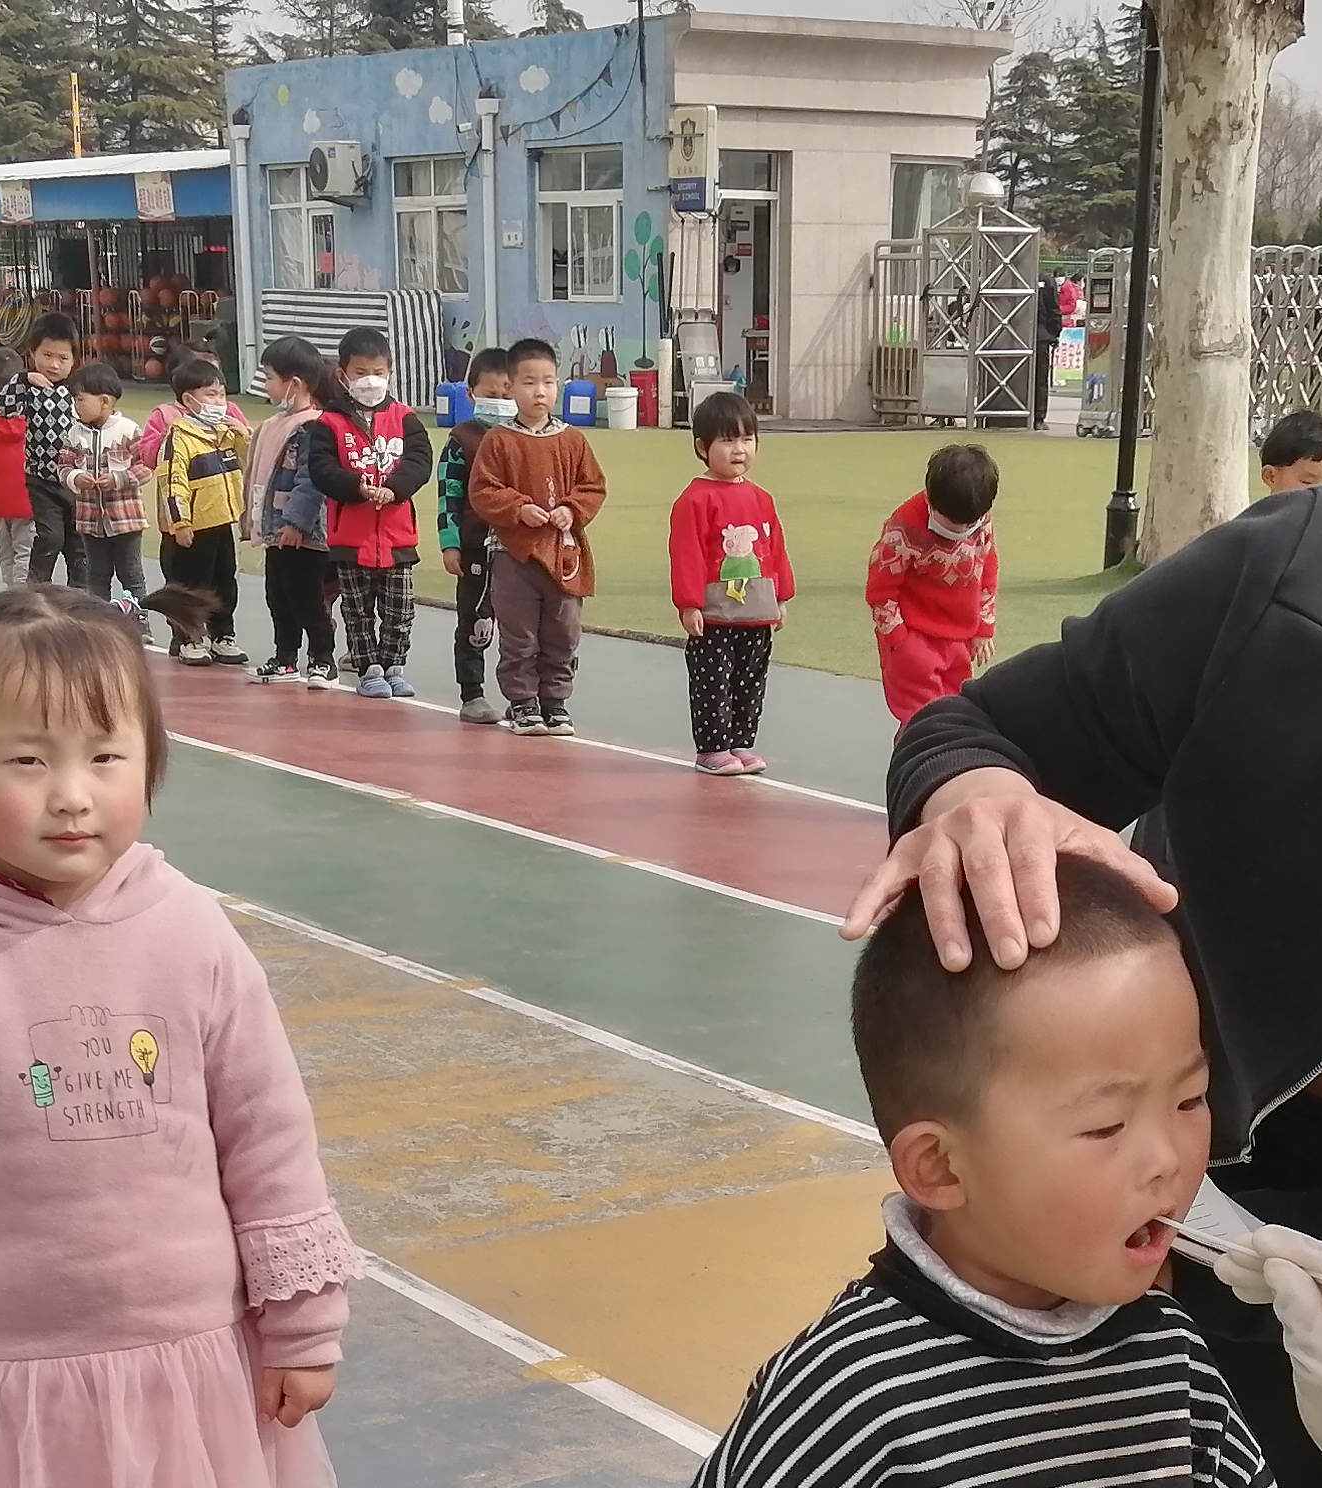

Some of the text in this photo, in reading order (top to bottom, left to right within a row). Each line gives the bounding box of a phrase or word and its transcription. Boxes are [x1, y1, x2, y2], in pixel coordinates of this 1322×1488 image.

[80, 1037, 112, 1058] YOU
[65, 1068, 133, 1093] GIVE ME
[63, 1099, 145, 1127] STRENGTH
